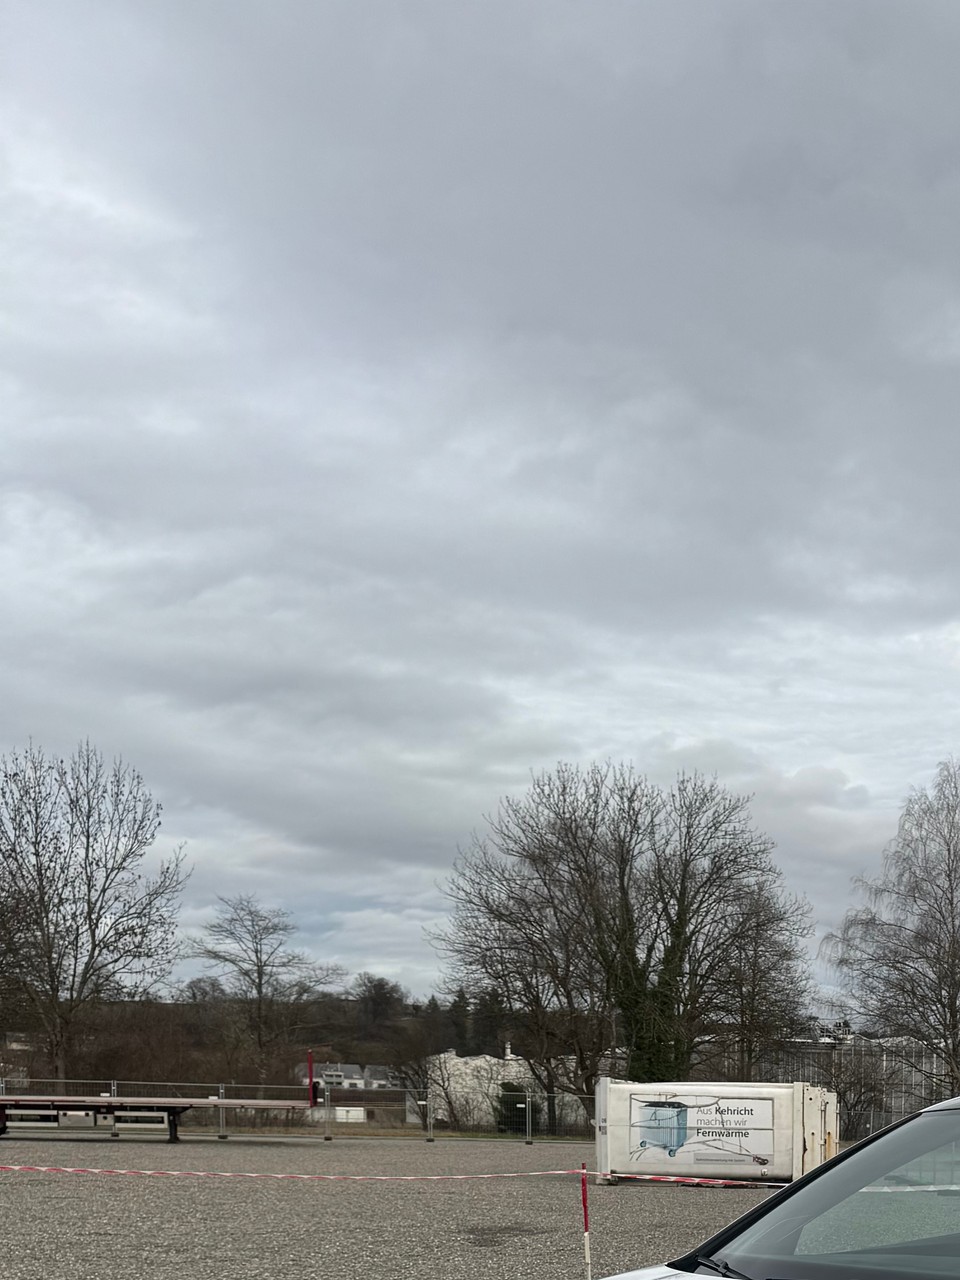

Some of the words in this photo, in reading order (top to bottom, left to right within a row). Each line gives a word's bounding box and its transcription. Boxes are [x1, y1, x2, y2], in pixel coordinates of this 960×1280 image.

[696, 1107, 713, 1115] Aus
[715, 1106, 754, 1116] Kehricht
[696, 1117, 732, 1126] machen
[733, 1118, 748, 1126] wir
[696, 1128, 750, 1138] Fernwärme
